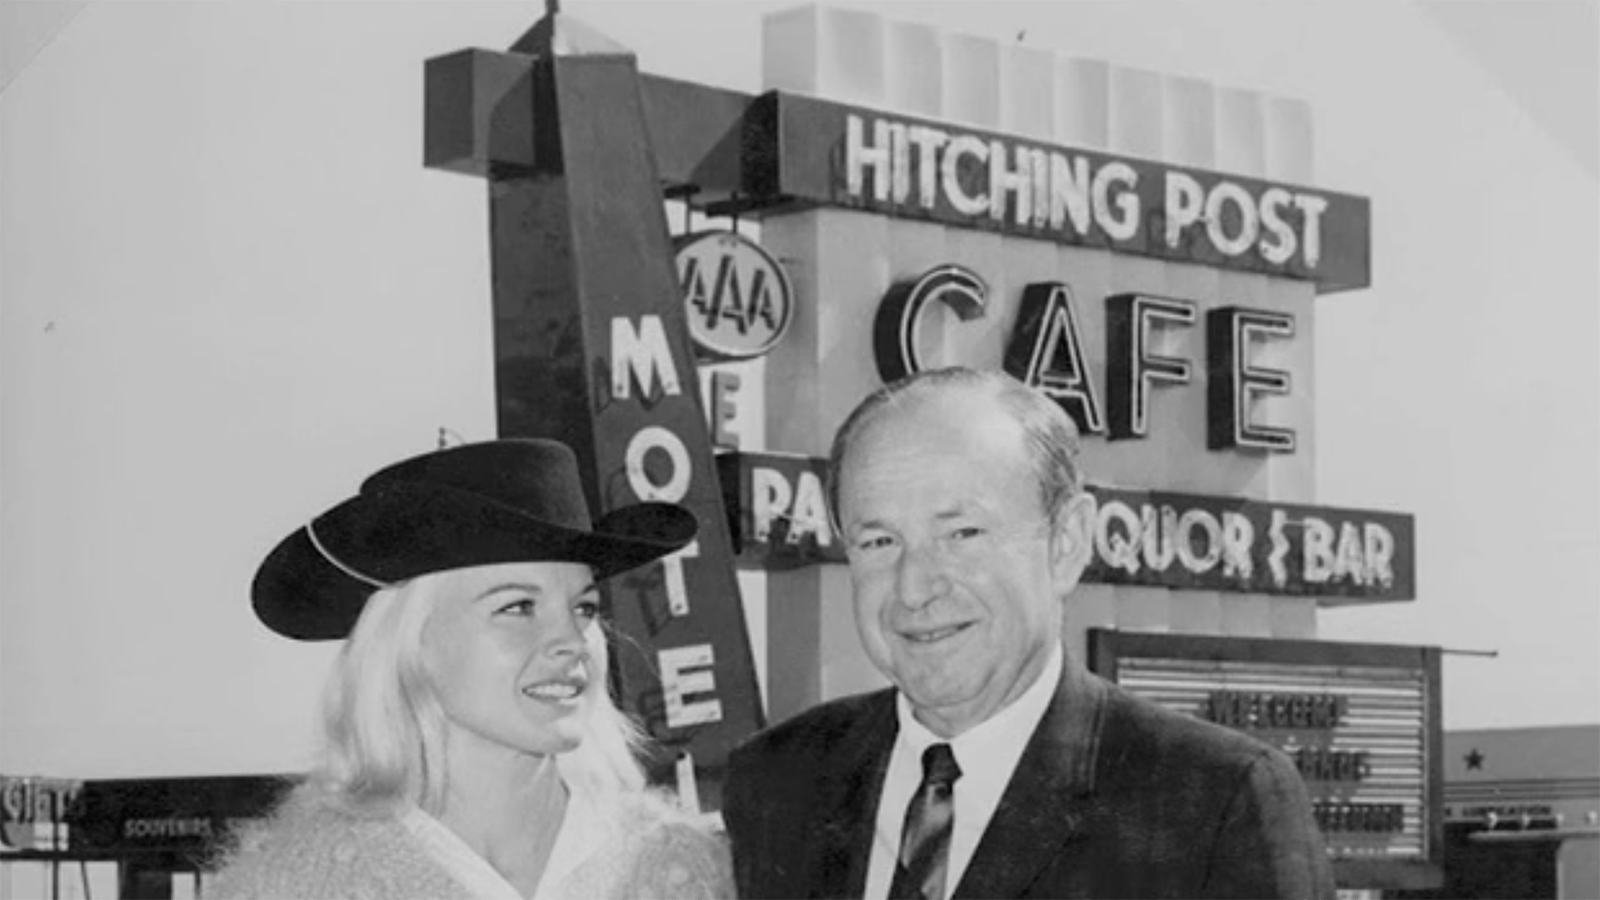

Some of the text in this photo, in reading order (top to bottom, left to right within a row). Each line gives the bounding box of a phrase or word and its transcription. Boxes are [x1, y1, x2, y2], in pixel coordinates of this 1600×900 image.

[846, 114, 1328, 269] HITCHING POST
[682, 254, 776, 336] AAA
[874, 264, 1297, 454] CAFE
[752, 467, 832, 547] PA
[1096, 500, 1254, 580] QUOR
[1302, 516, 1394, 589] BAR
